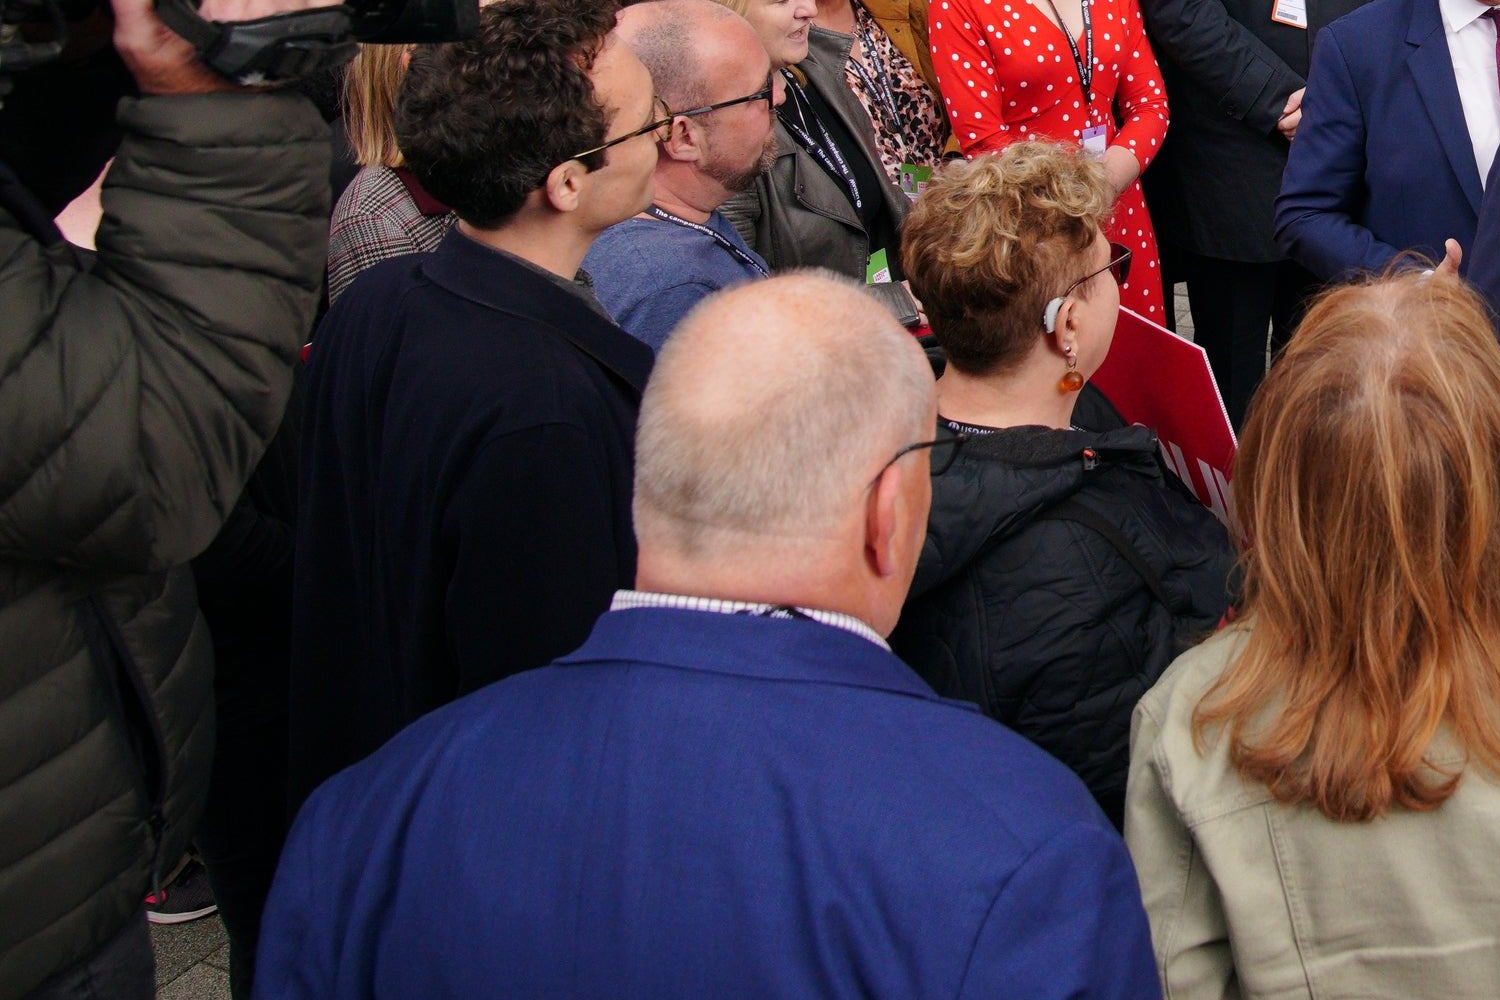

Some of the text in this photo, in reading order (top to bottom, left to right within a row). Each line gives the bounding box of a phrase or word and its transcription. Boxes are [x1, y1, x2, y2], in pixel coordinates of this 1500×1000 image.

[655, 208, 668, 218] The
[668, 214, 714, 236] campaigning
[714, 232, 731, 247] union
